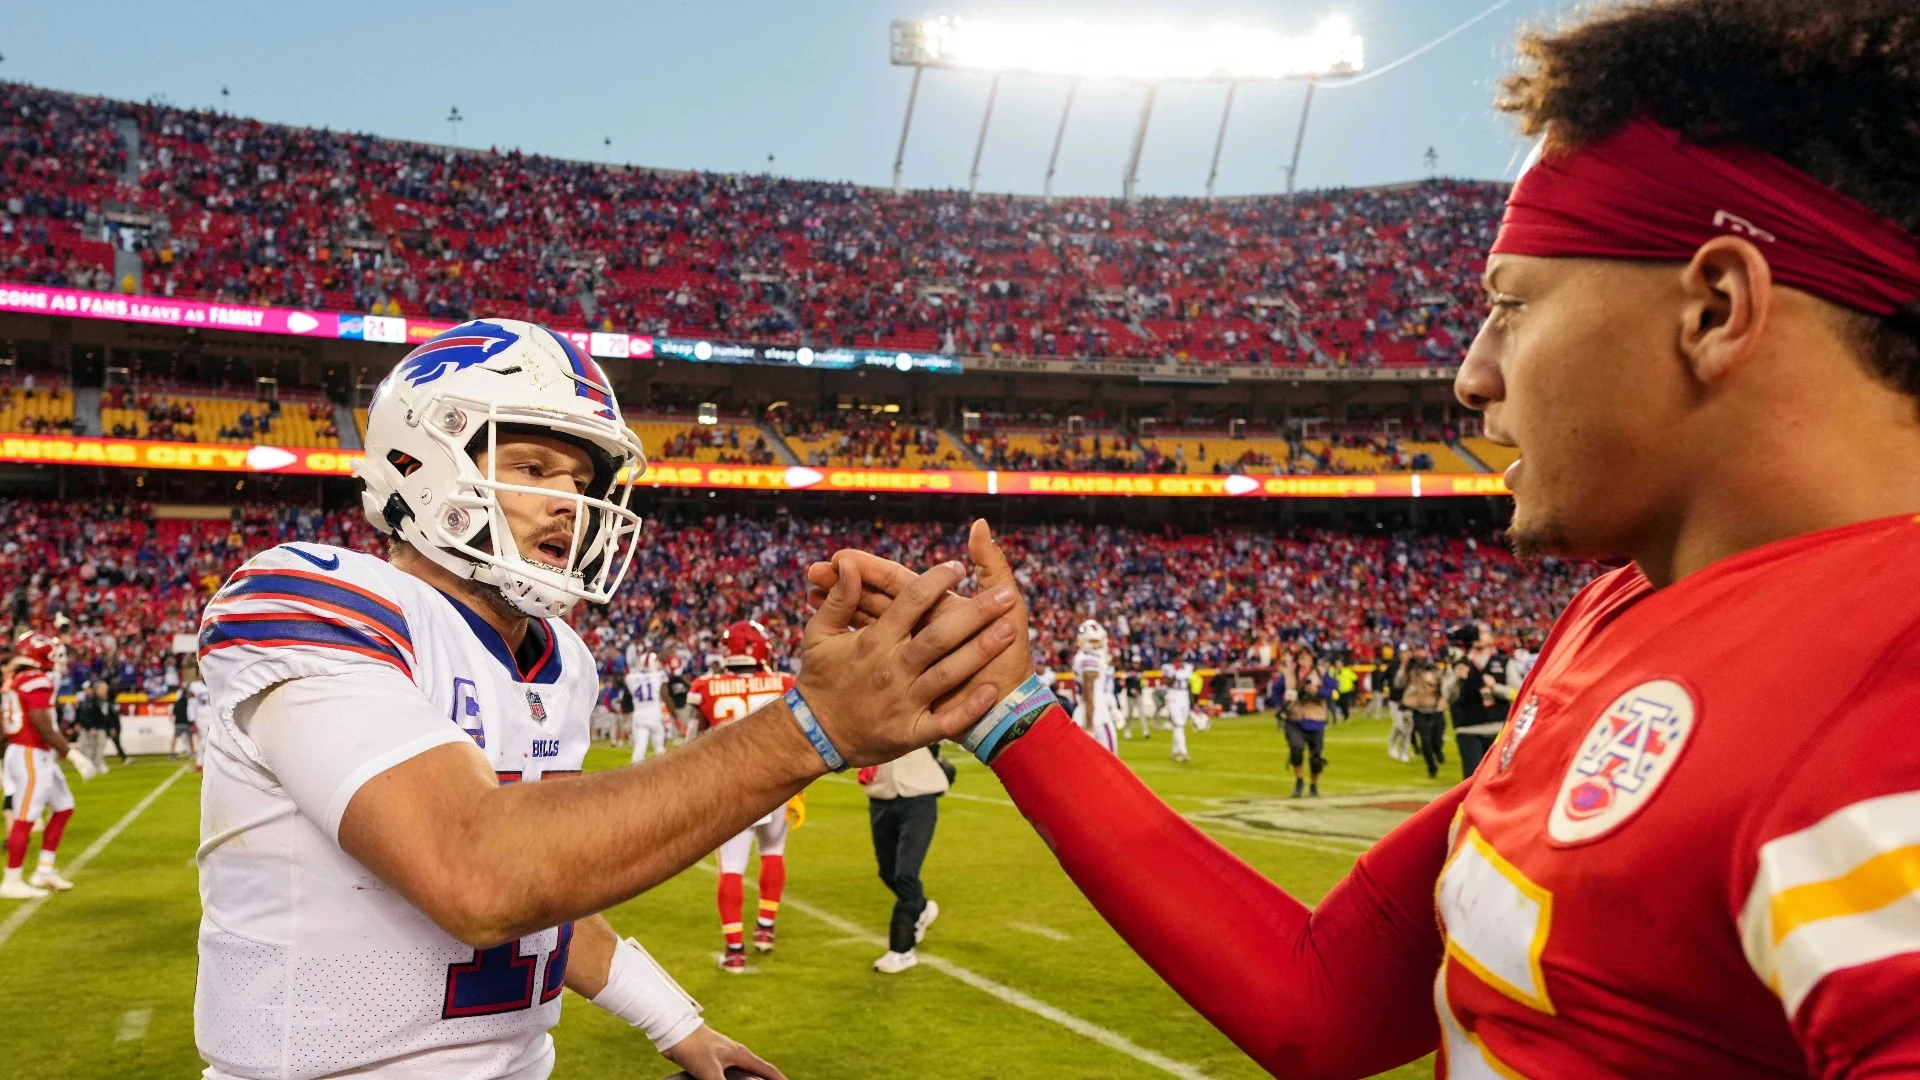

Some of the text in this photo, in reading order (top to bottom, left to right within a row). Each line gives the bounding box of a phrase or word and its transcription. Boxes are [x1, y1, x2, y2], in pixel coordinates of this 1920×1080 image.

[50, 294, 78, 311] AS
[80, 297, 128, 316] FANS
[131, 304, 181, 321] LEAVE
[184, 309, 206, 323] AS
[209, 307, 263, 327] FAMILY
[368, 320, 386, 337] 24
[661, 341, 755, 358] sleep number
[764, 347, 796, 362] sleep
[865, 353, 895, 368] sleep
[0, 438, 137, 463] NSAS
[145, 446, 248, 468] CITY
[708, 469, 788, 487] CITY
[830, 471, 952, 490] CHIEFS
[1029, 476, 1376, 494] KANSAS CITY CHIEFS
[634, 683, 653, 702] 41
[532, 739, 560, 758] BILLS
